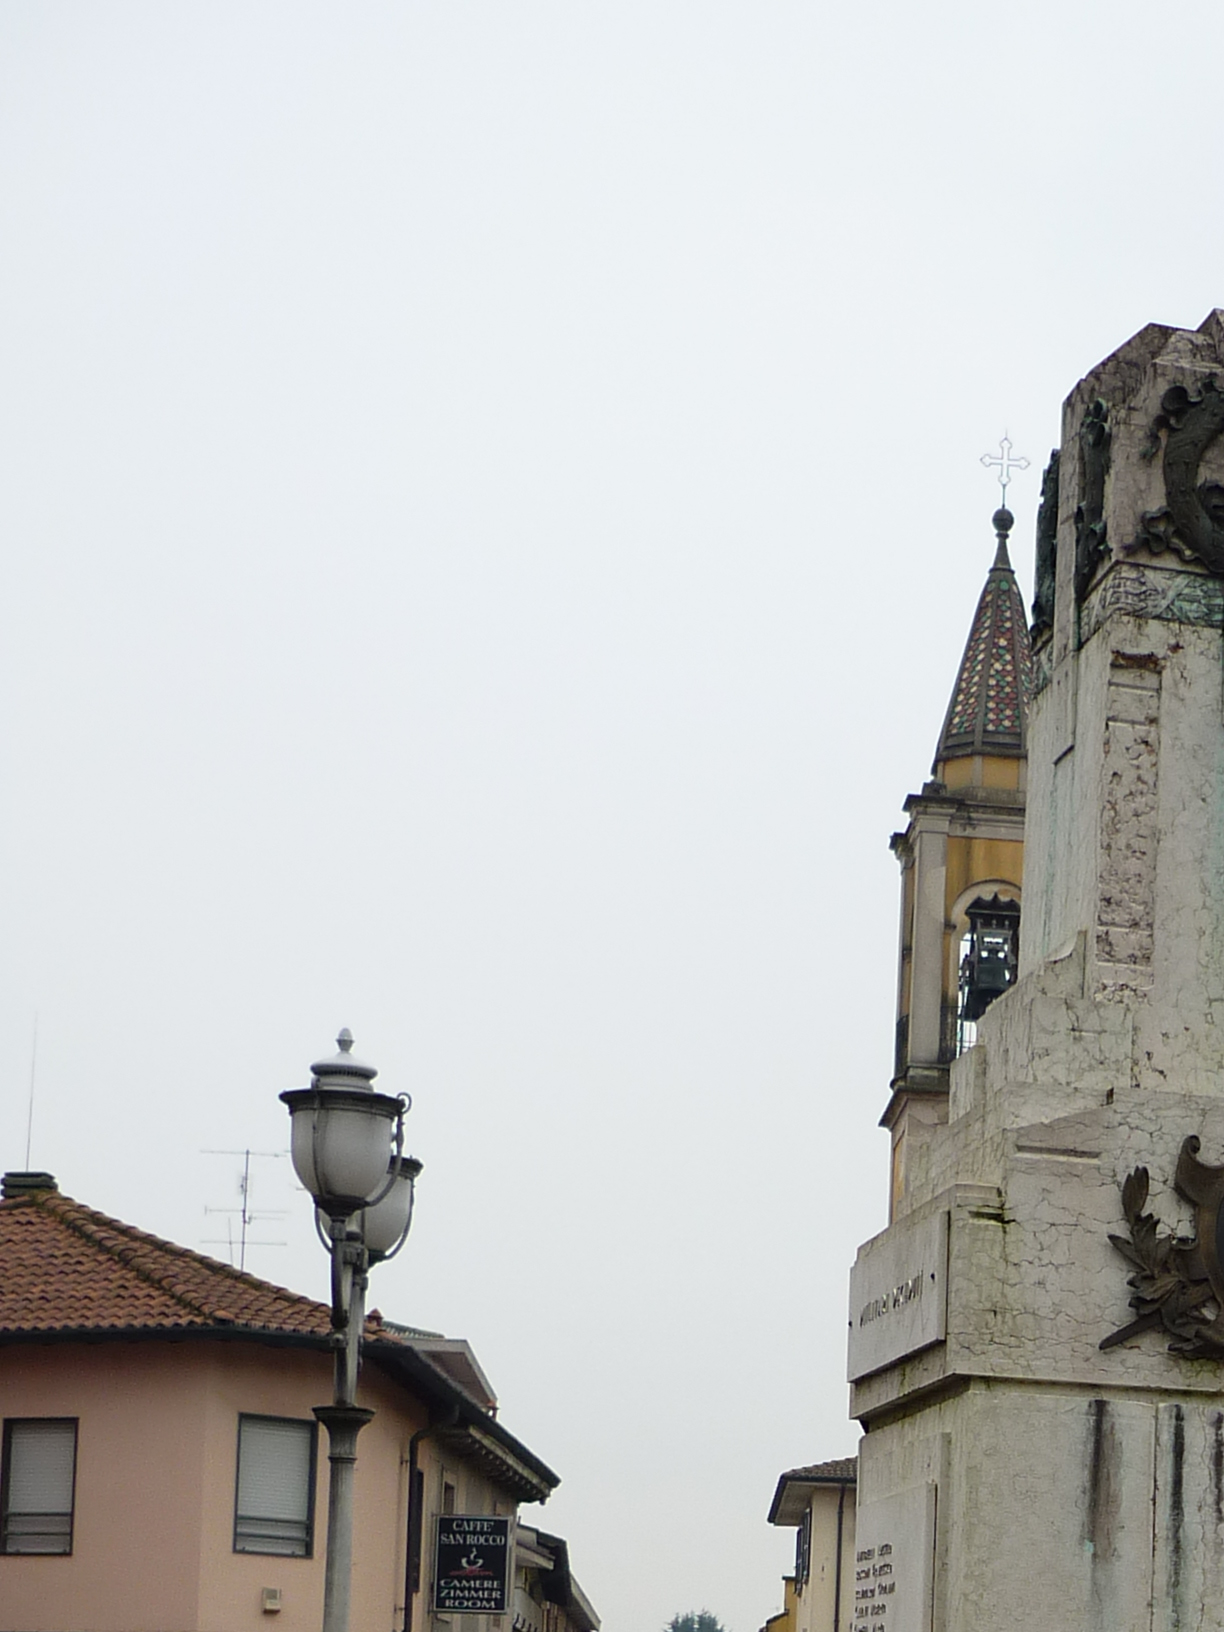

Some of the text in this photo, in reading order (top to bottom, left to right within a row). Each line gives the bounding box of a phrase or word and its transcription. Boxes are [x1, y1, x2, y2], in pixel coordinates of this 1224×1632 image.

[440, 1533, 505, 1546] SAN ROCCO
[440, 1579, 501, 1589] CAMERE
[440, 1589, 502, 1599] ZIMMER
[445, 1599, 496, 1609] ROOM
